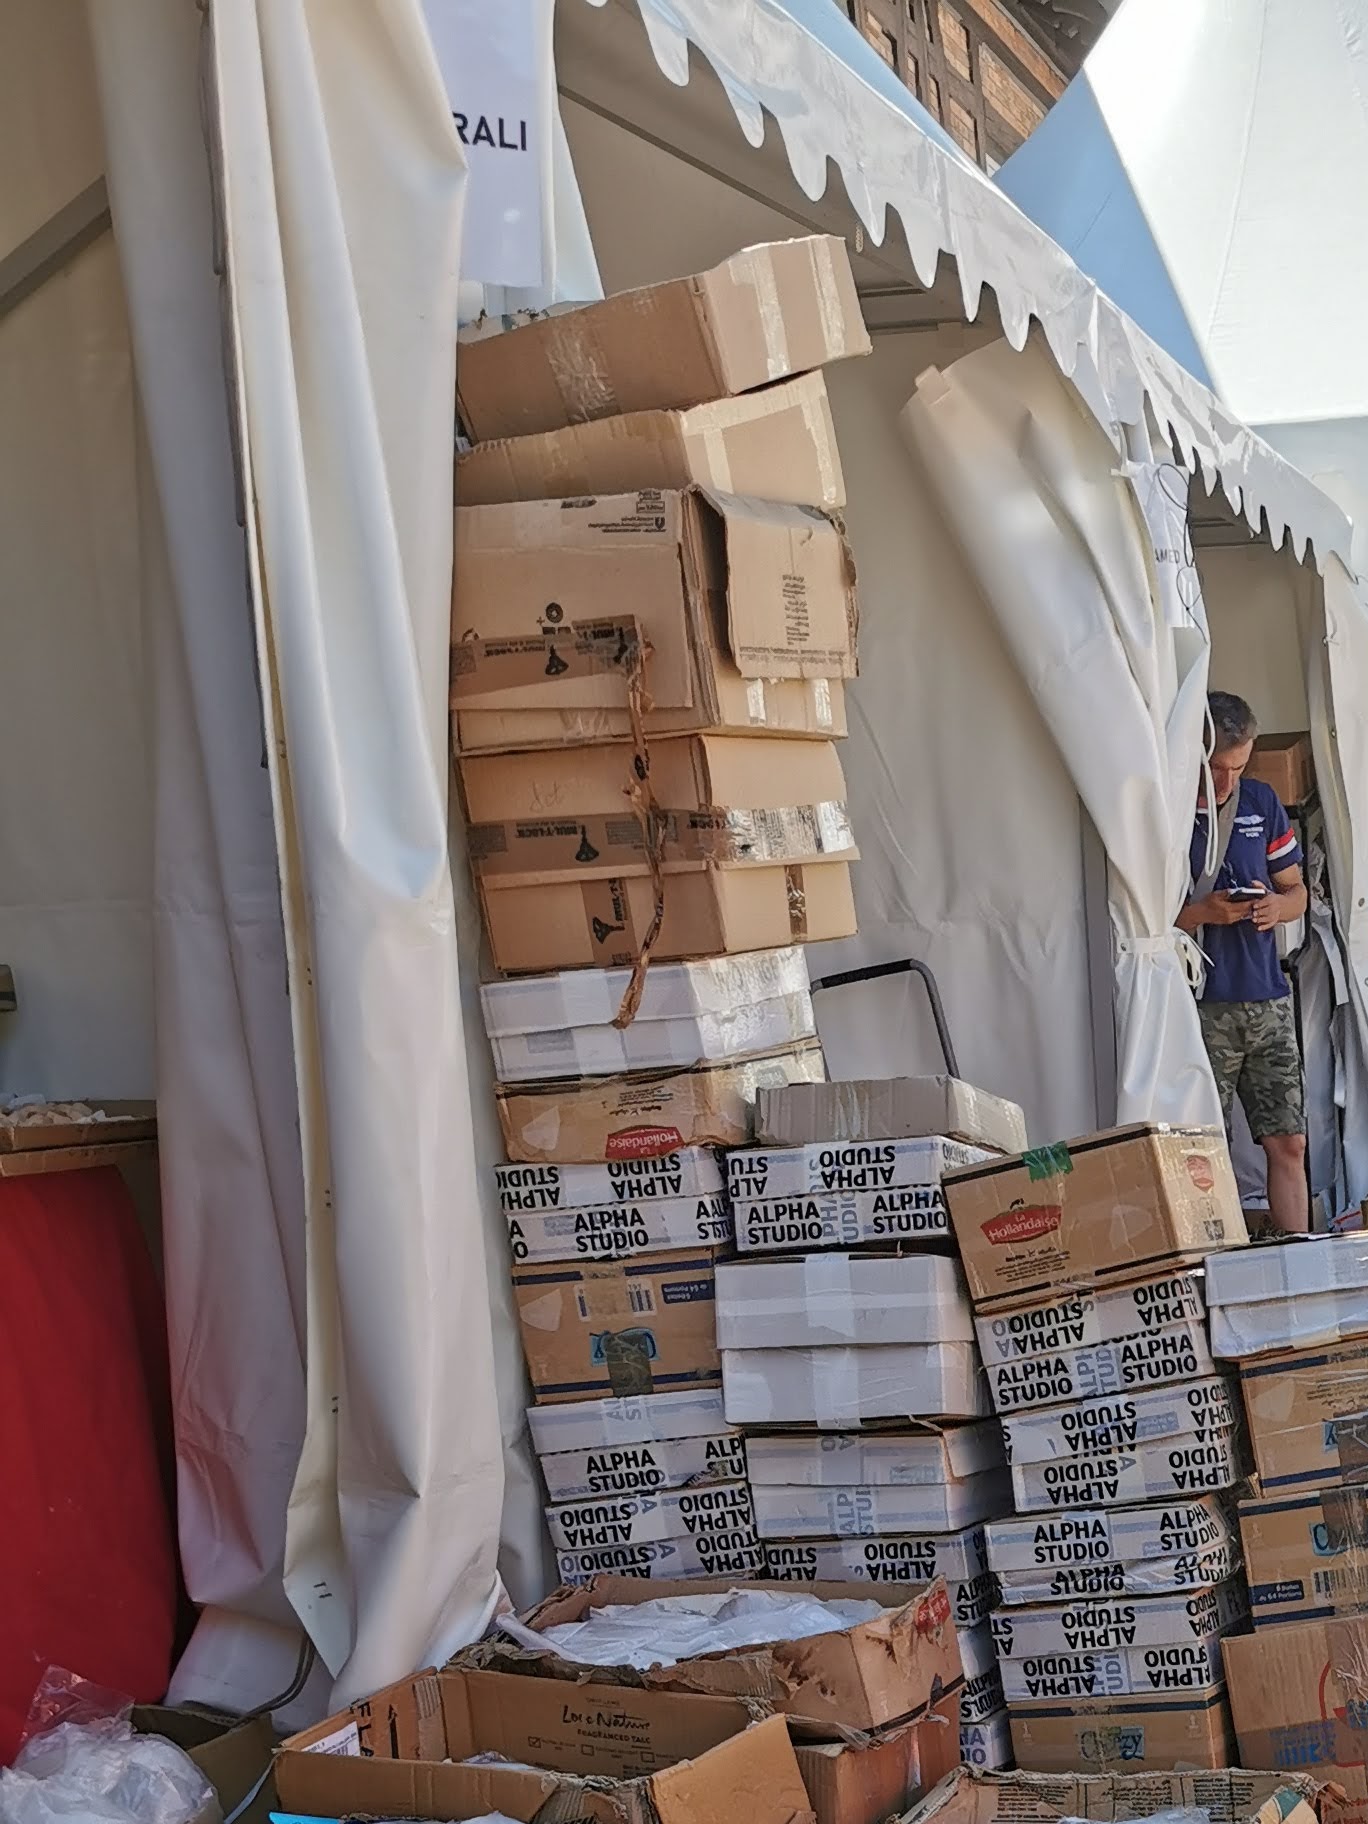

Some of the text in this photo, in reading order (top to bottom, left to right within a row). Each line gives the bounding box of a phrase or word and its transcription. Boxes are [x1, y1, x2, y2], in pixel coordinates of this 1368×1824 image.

[608, 1131, 679, 1149] Hollandaise
[608, 1153, 682, 1177] STUDIO
[819, 1145, 896, 1168] STUDIO
[496, 1166, 560, 1189] STUDI
[611, 1175, 682, 1199] ALPHA
[820, 1166, 895, 1189] ALPHA
[501, 1187, 560, 1210] ALPH
[873, 1190, 946, 1213] ALPHA
[574, 1207, 645, 1233] ALPHA
[747, 1201, 821, 1225] ALPHA
[873, 1211, 947, 1234] STUDIO
[576, 1229, 649, 1253] STUDIO
[747, 1222, 823, 1245] STUDIO
[1009, 1303, 1085, 1333] STUDIO
[1013, 1322, 1085, 1354] ALPHA
[1121, 1334, 1193, 1363] ALPHA
[997, 1357, 1069, 1385] ALPHA
[1123, 1355, 1198, 1383] STUDIO
[998, 1377, 1073, 1405] STUDIO
[1061, 1401, 1136, 1430] STUDIO
[1065, 1421, 1138, 1451] ALPHA
[587, 1449, 656, 1474] ALPHA
[1044, 1459, 1118, 1484] STUDIO
[588, 1469, 660, 1493] STUDIO
[1046, 1479, 1119, 1505] ALPHA
[679, 1487, 749, 1513] STUDIO
[560, 1504, 632, 1528] STUDIO
[682, 1506, 751, 1533] ALPHA
[1160, 1503, 1211, 1531] ALPHA
[564, 1523, 632, 1547] ALPHA
[1034, 1519, 1107, 1543] ALPHA
[1160, 1521, 1220, 1551] STUDIO
[581, 1548, 652, 1571] STUDIO
[864, 1541, 936, 1561] STUDIO
[1034, 1540, 1110, 1564] STUDIO
[866, 1560, 936, 1581] ALPHA
[1055, 1563, 1126, 1583] ALPHA
[1050, 1576, 1125, 1596] STUDIO
[1061, 1606, 1136, 1629] STUDIO
[1064, 1626, 1137, 1649] ALPHA
[1023, 1655, 1095, 1677] STUDIO
[1026, 1674, 1096, 1697] ALPHA
